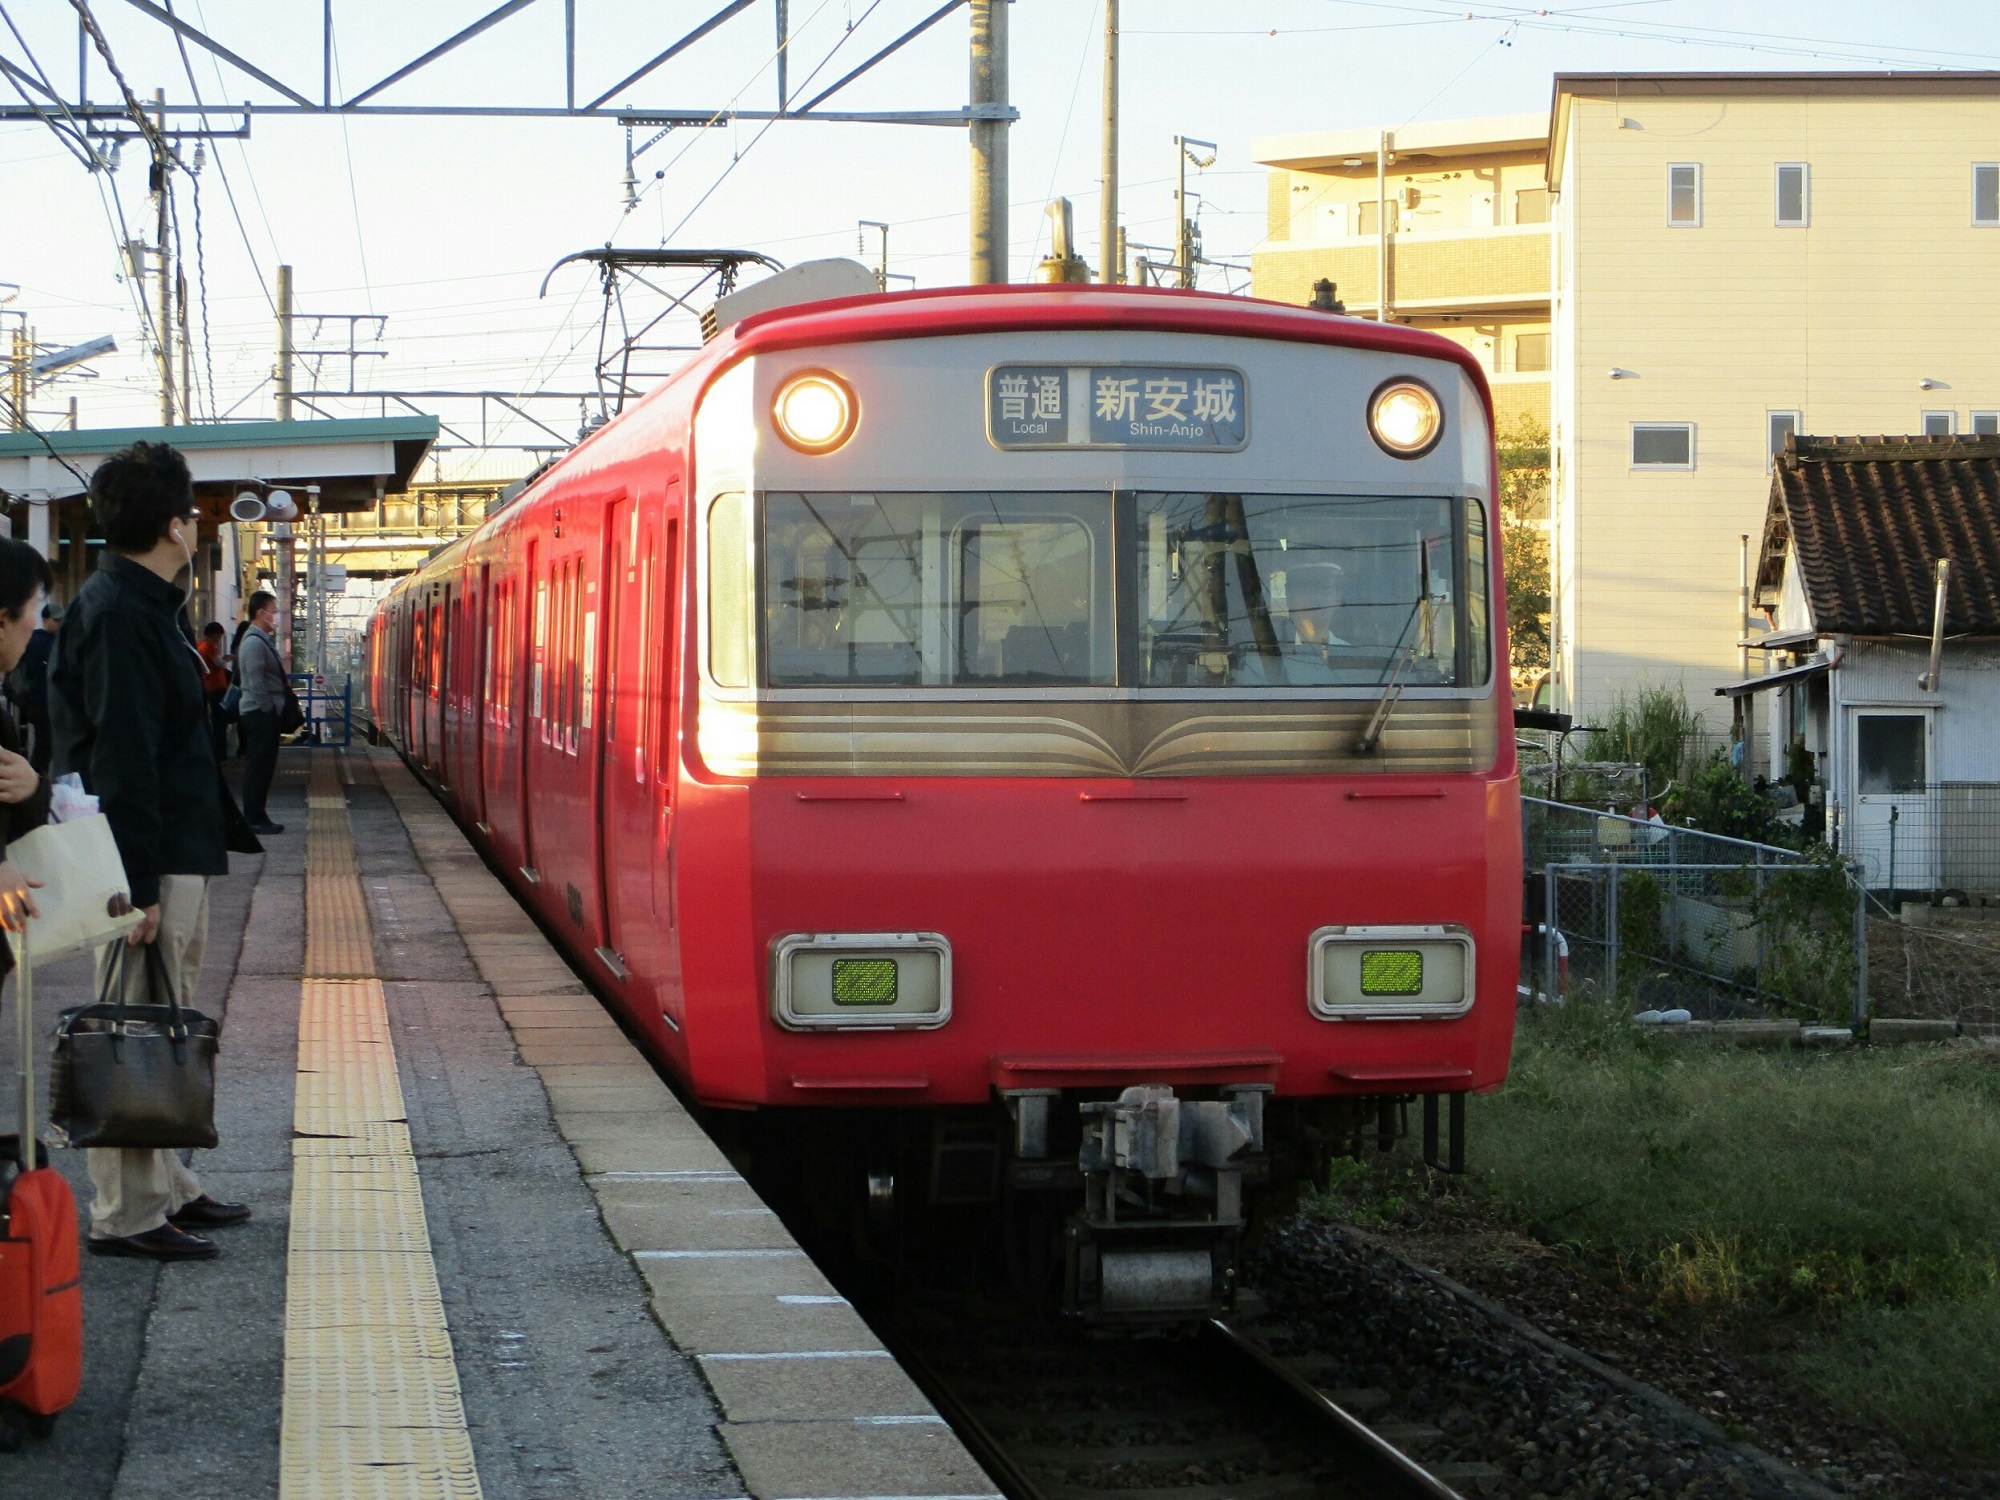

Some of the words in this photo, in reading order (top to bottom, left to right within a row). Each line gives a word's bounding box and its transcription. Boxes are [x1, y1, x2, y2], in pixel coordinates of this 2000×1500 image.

[999, 375, 1061, 419] 普通
[1096, 376, 1236, 422] 新安城
[1012, 421, 1048, 434] Local
[1130, 422, 1204, 438] Shin-Anjo
